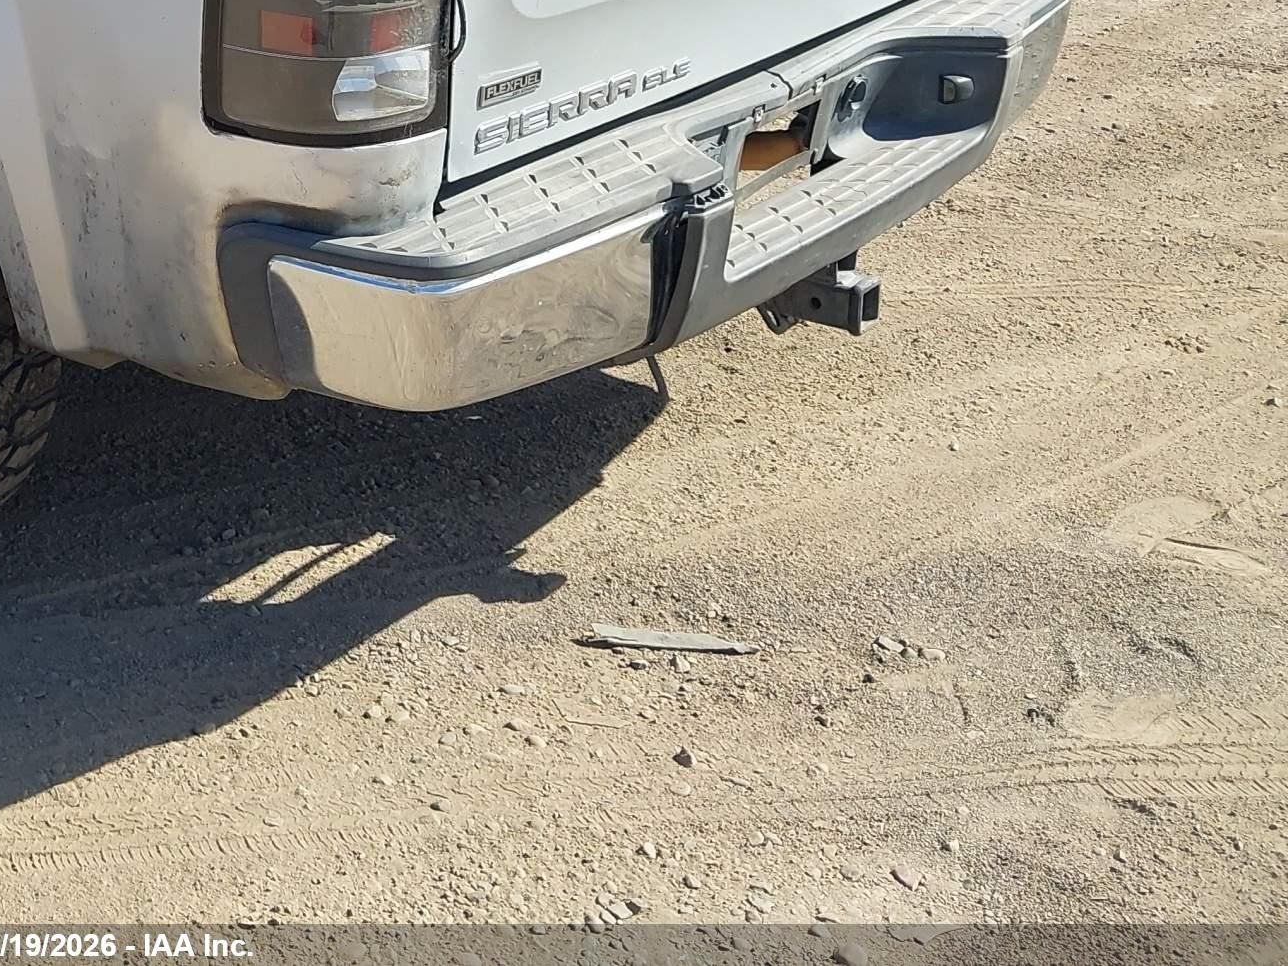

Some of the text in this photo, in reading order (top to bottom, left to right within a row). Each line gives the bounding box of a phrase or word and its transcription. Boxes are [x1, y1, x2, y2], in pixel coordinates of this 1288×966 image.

[474, 57, 691, 155] SIERRA SLE
[486, 72, 541, 100] FLEXFUEL
